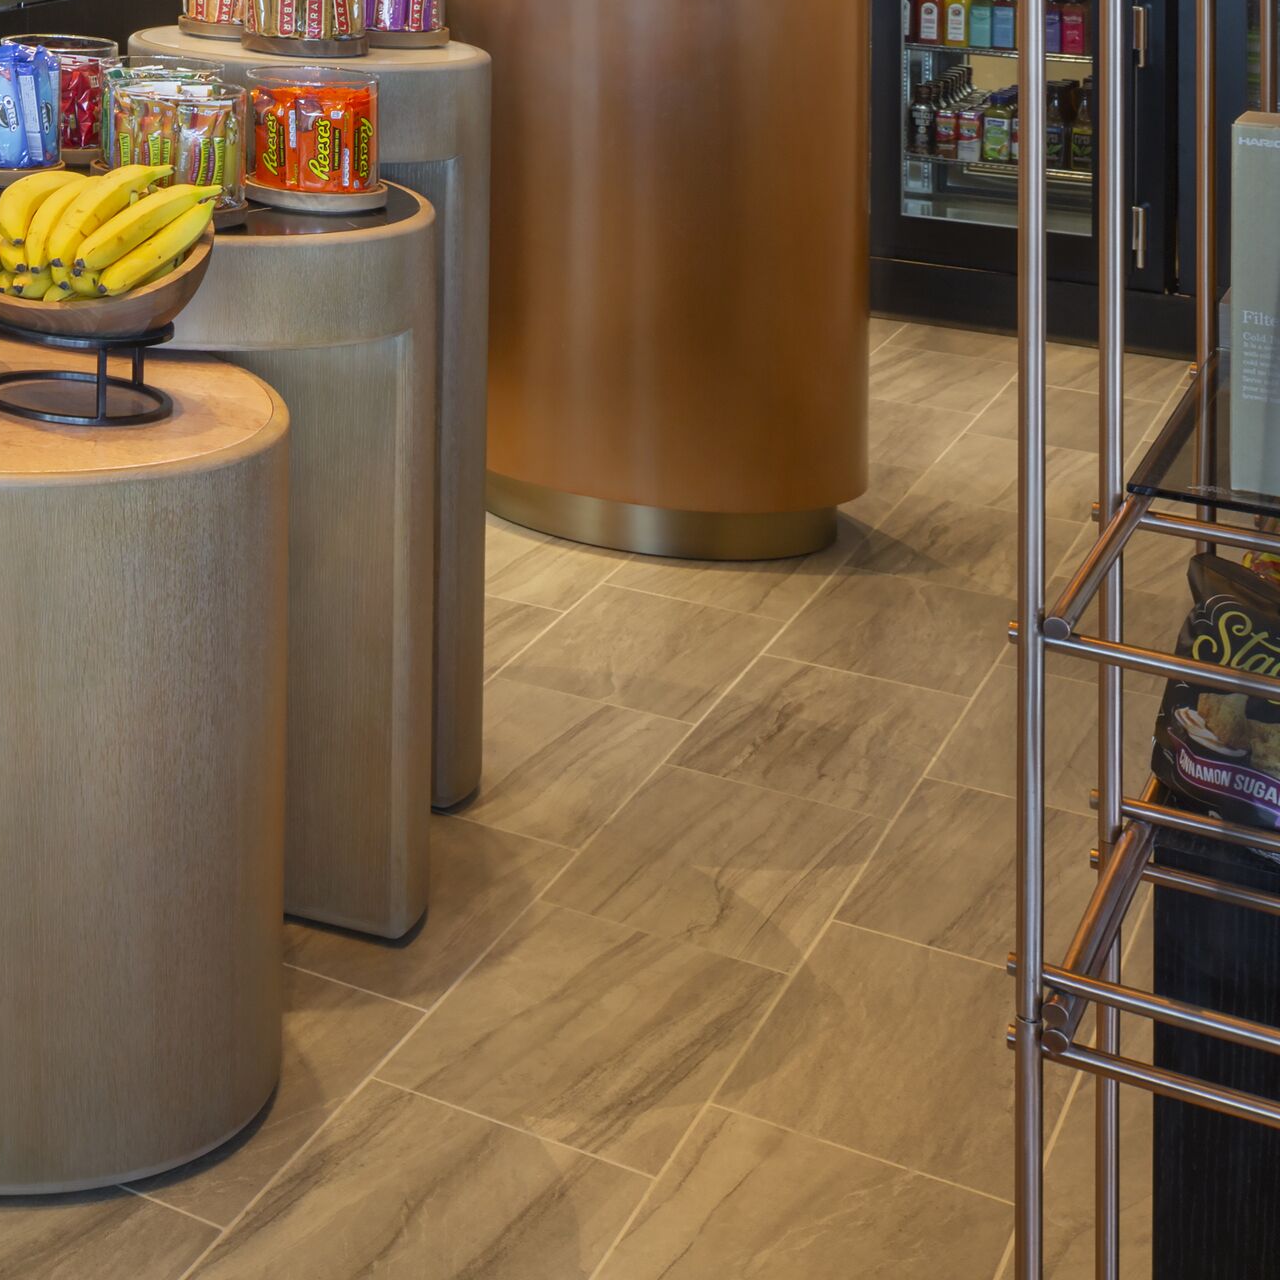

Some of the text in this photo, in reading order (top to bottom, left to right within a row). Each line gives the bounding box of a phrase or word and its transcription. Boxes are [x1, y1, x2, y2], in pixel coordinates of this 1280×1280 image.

[2, 94, 19, 132] OREO
[262, 112, 279, 176] Reese's
[308, 118, 331, 181] Reese's
[359, 117, 374, 178] Reese's
[1179, 748, 1280, 806] CINNAMON SUGA
